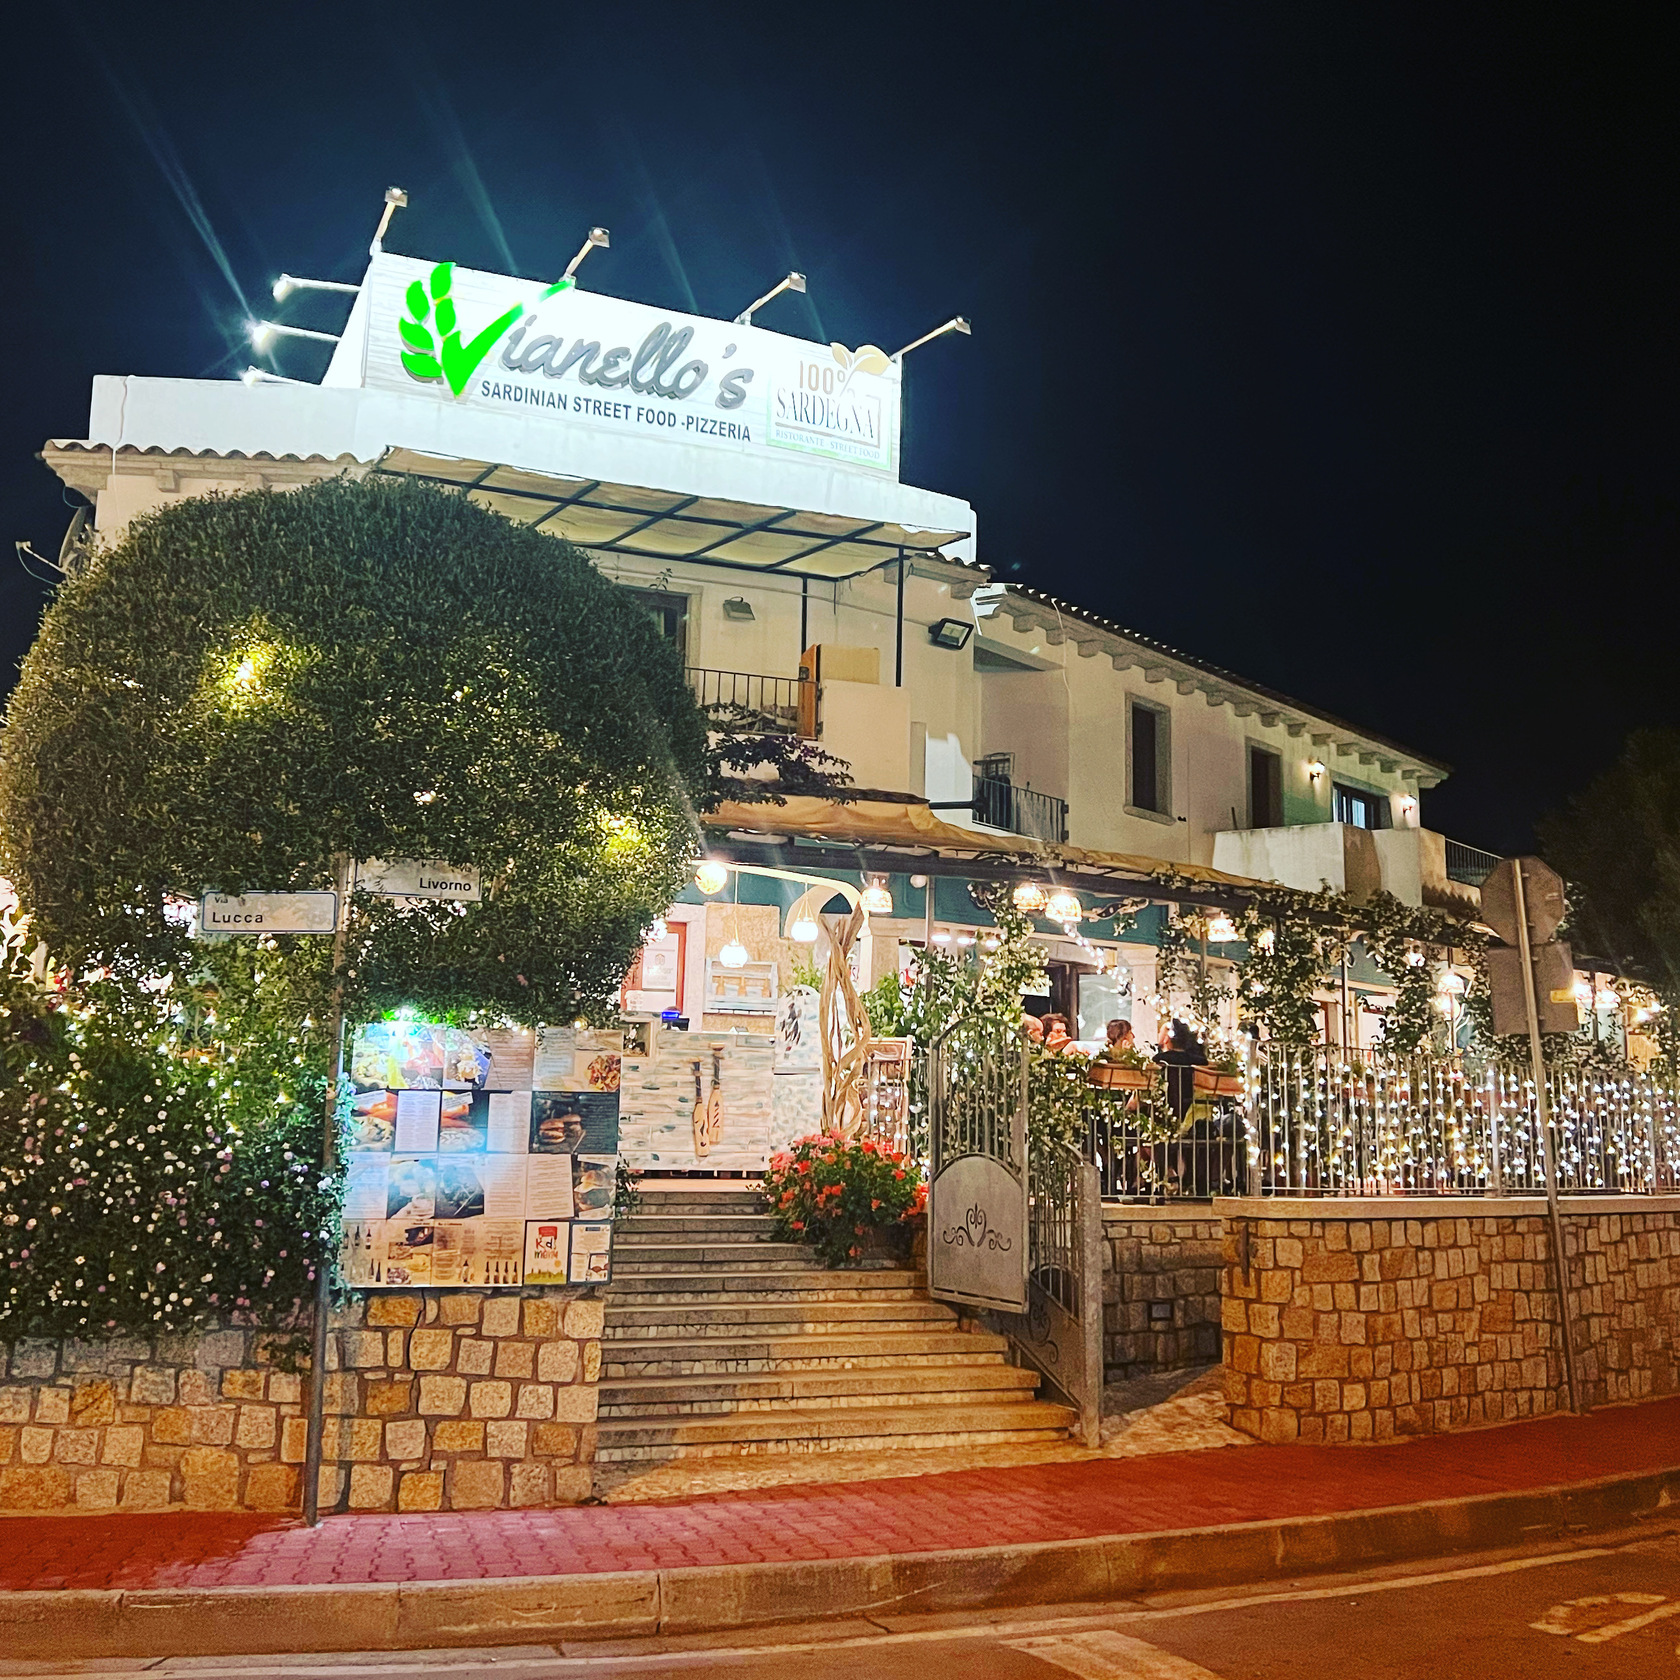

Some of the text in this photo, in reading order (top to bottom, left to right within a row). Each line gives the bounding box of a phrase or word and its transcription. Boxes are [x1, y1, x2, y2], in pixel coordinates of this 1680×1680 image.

[481, 380, 568, 411] SARDINIAN
[572, 395, 632, 421] STREET
[636, 406, 677, 428] FOOD
[776, 387, 874, 438] SARDEGNA
[775, 429, 825, 447] RISTORANTE
[419, 877, 472, 892] Livorno
[212, 911, 264, 924] Lucca
